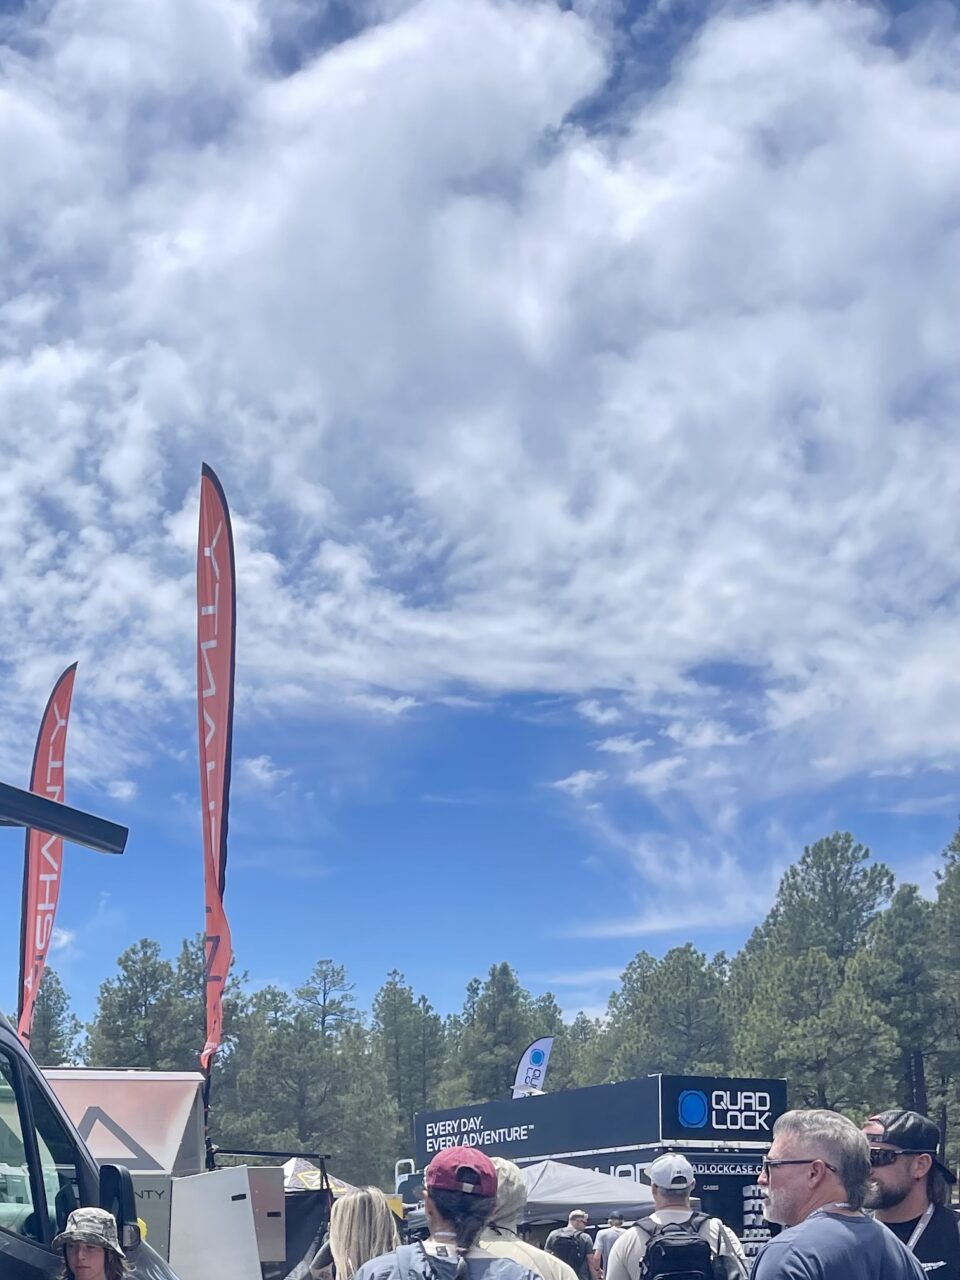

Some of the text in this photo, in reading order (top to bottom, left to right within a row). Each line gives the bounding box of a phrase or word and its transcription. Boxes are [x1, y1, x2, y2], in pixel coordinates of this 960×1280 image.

[712, 1090, 770, 1110] QUAD
[426, 1116, 483, 1136] EVERY DAY.
[426, 1135, 460, 1152] EVERY
[693, 1164, 764, 1174] ADLOCKCASE.C
[134, 1190, 165, 1199] NTY
